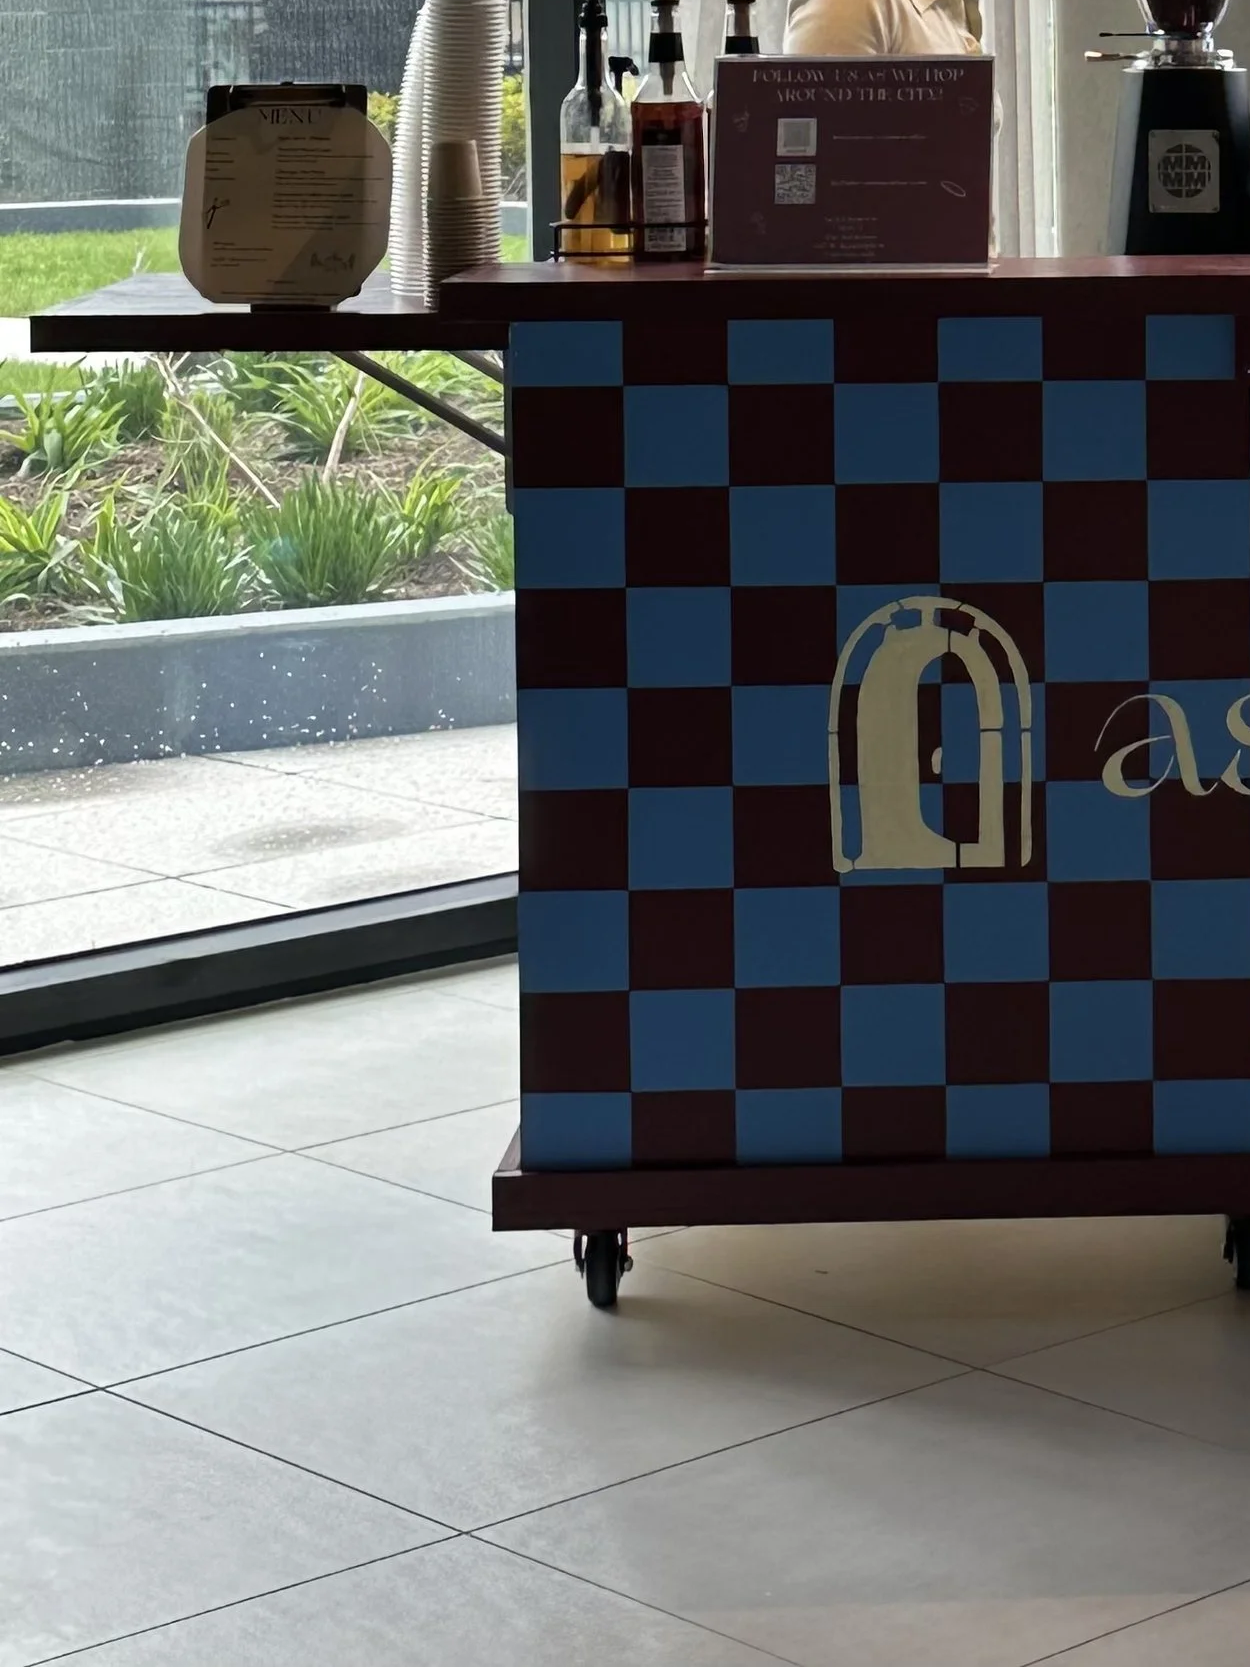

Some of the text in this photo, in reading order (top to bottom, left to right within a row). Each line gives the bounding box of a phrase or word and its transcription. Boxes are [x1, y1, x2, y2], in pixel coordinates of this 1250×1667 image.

[753, 69, 824, 83] FOLLOW
[892, 68, 919, 82] WE
[925, 68, 964, 83] HOP
[777, 88, 852, 102] AROUND
[854, 88, 892, 102] THE
[258, 108, 322, 125] MENU
